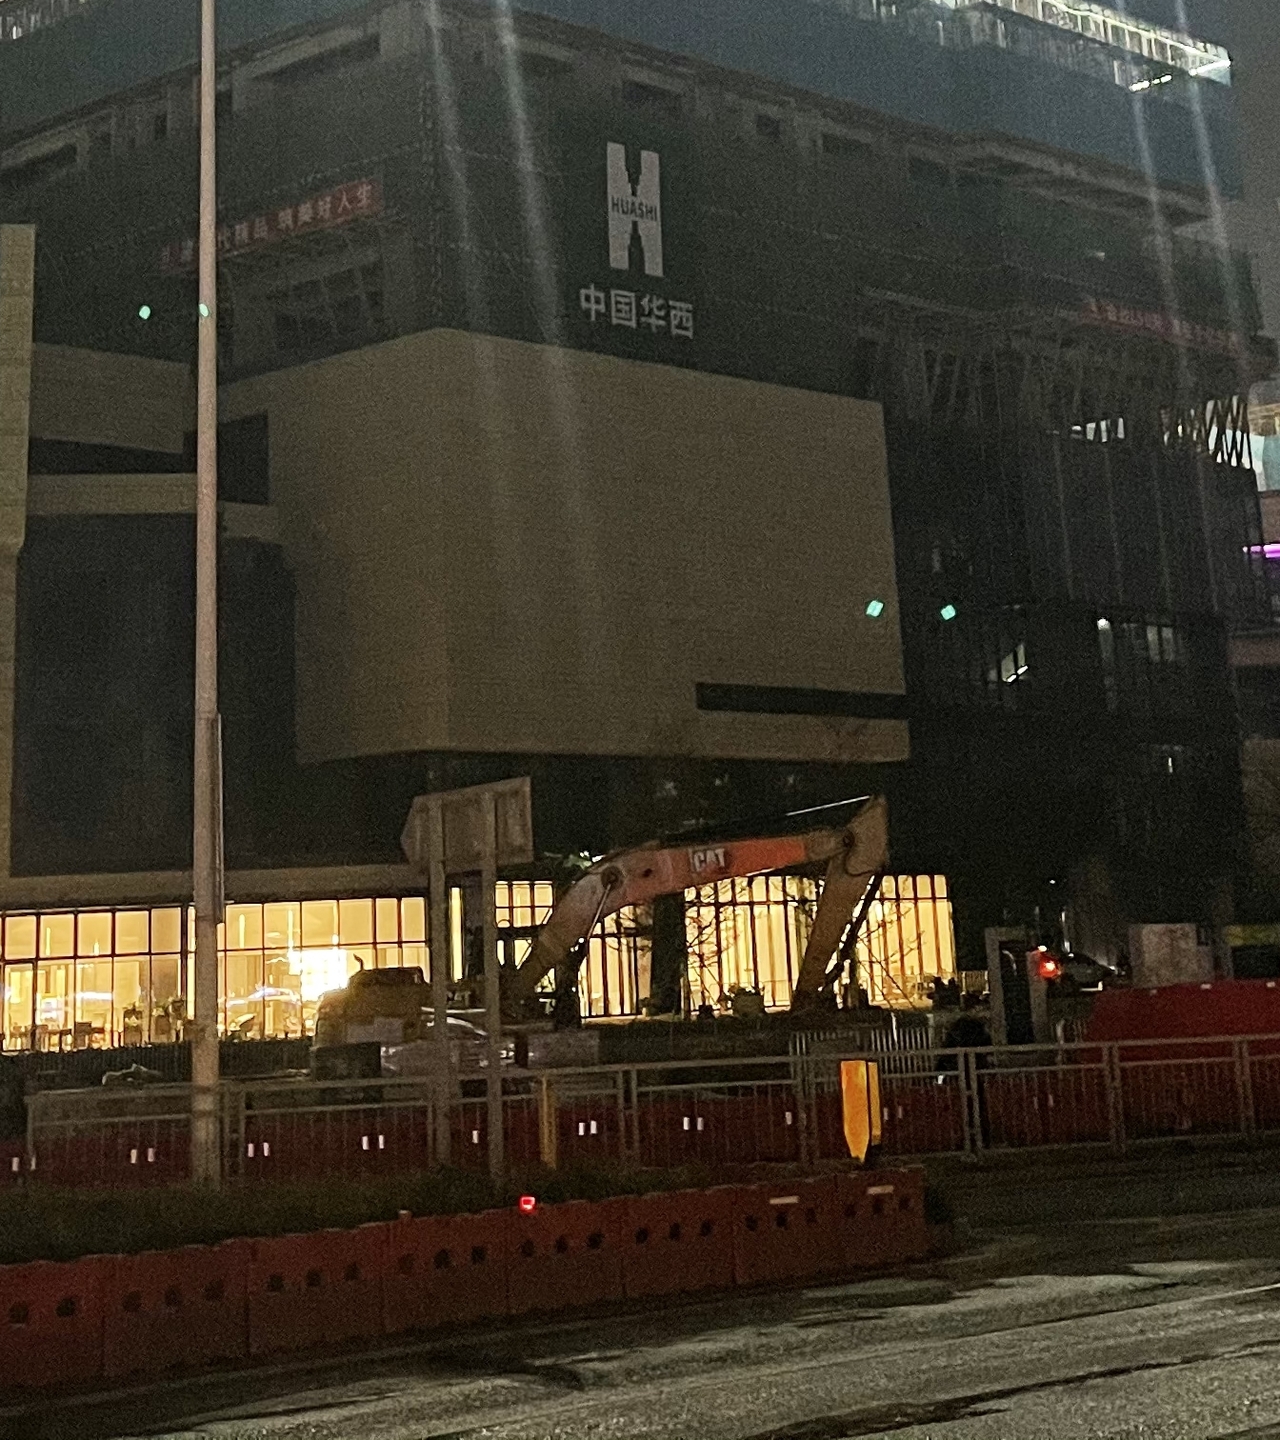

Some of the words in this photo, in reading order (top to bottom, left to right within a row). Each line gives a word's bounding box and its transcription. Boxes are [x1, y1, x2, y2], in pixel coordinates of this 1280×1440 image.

[611, 197, 658, 222] HUASHI
[579, 283, 694, 338] 中国华西
[693, 848, 725, 872] CAT
